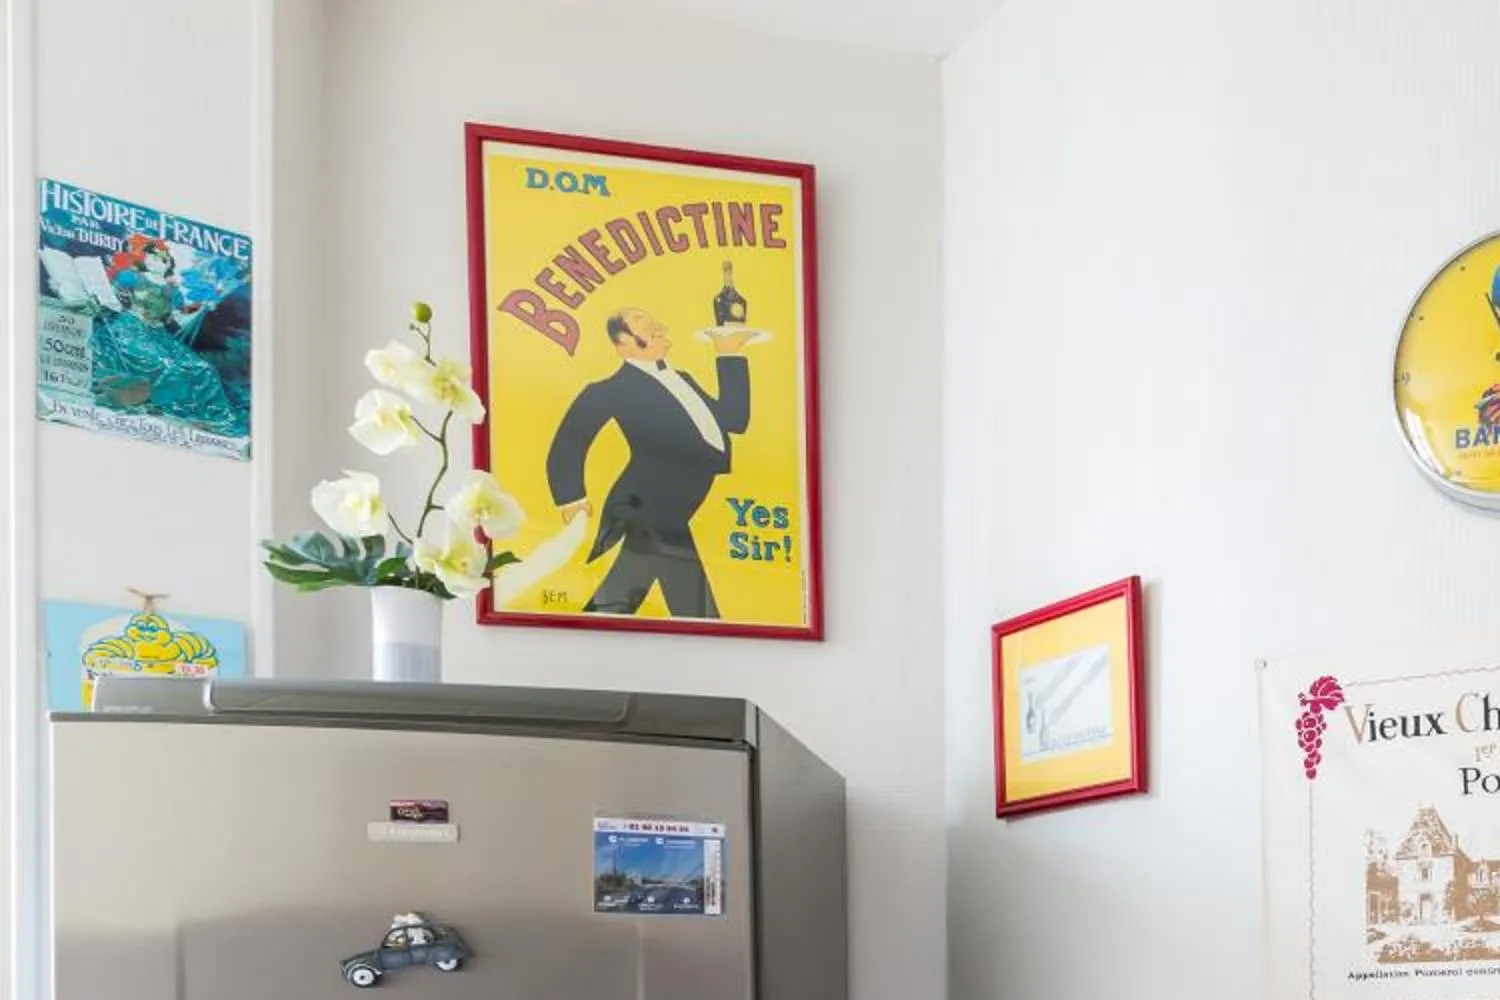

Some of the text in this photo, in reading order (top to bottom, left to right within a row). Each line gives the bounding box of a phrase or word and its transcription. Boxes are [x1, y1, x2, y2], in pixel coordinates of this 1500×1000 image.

[40, 179, 146, 232] HISTOIRE
[159, 212, 250, 261] FRANCE
[496, 200, 788, 357] BENEDICTINE
[726, 497, 789, 528] Yes
[729, 532, 792, 562] Sir!
[1343, 703, 1448, 744] Vieux
